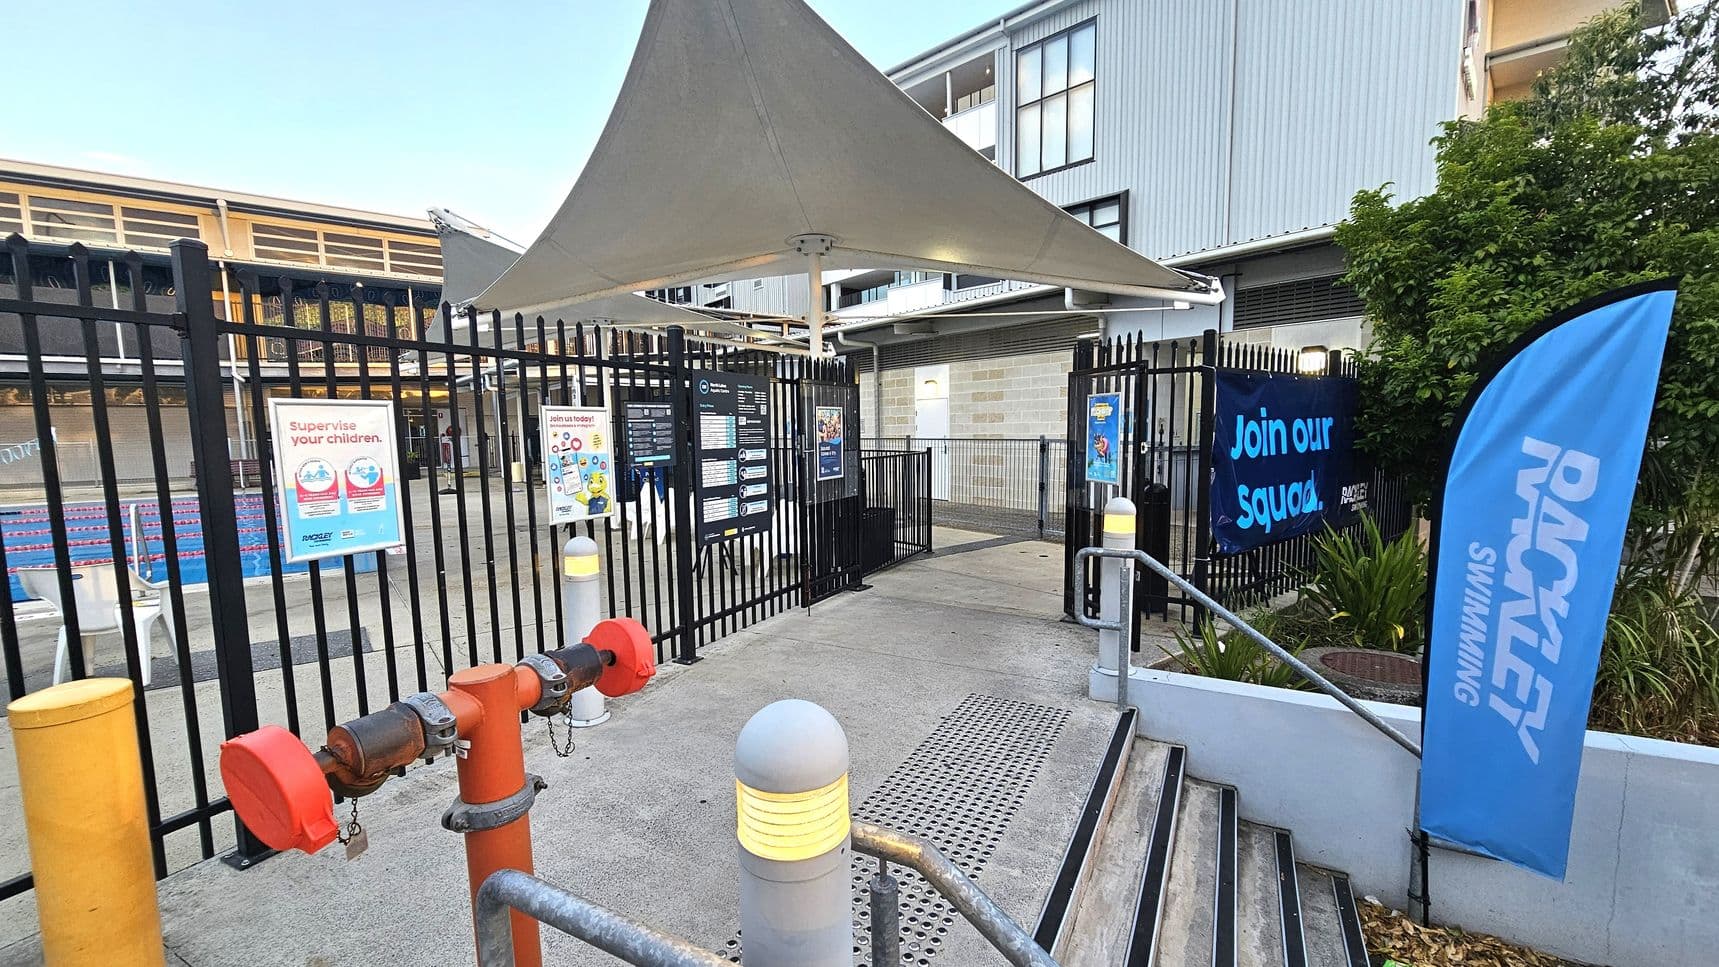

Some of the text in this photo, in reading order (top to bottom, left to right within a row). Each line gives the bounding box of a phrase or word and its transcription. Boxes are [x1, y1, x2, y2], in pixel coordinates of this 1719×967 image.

[289, 420, 357, 433] Supervise
[550, 414, 563, 422] Join
[573, 415, 594, 423] today!
[1231, 407, 1333, 460] Join our
[291, 433, 383, 447] your children.
[1236, 470, 1323, 534] squad.
[302, 531, 333, 542] RACKLEY
[1489, 436, 1600, 765] RACKLEY
[1454, 541, 1497, 708] SWIMMING
